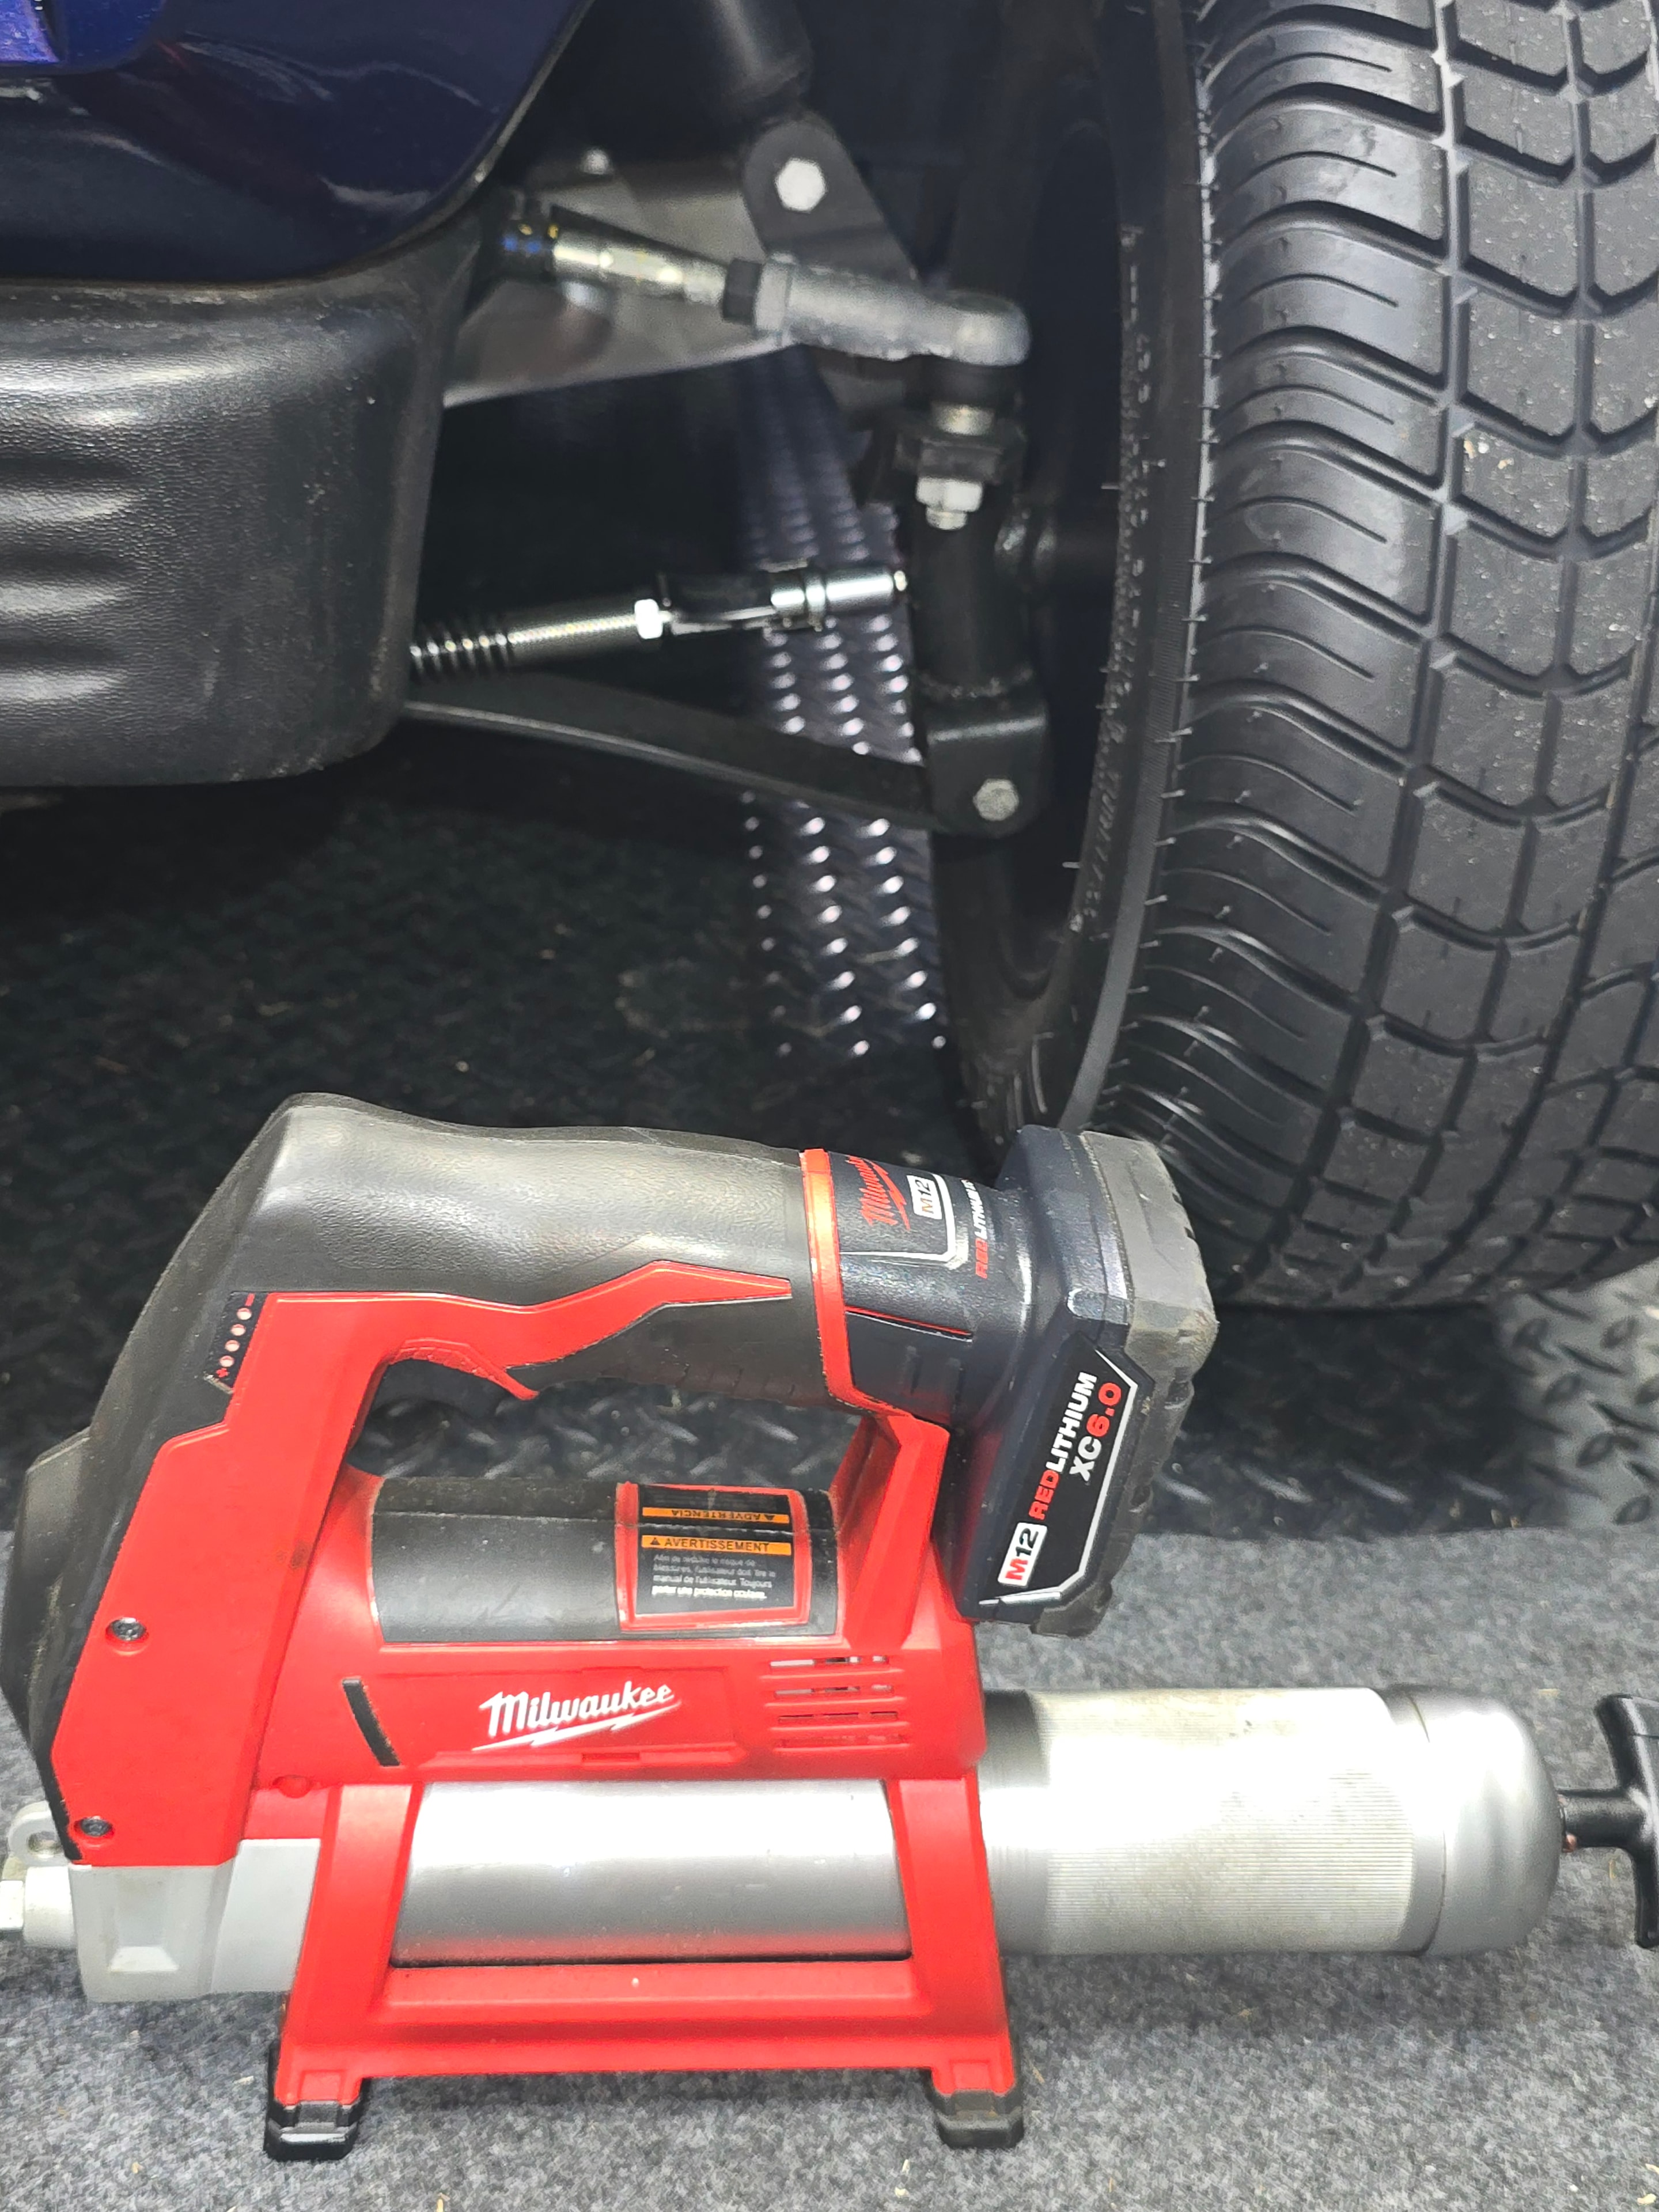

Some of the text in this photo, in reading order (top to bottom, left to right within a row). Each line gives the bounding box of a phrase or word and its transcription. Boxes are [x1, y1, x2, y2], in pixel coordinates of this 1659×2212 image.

[915, 1179, 935, 1214] M12
[1070, 1382, 1122, 1482] XC6.0
[1005, 1372, 1097, 1580] M12 REDLITHIUM
[671, 1509, 760, 1520] ADVERTENCIA
[664, 1537, 769, 1552] AVERTISSEMENT
[479, 1680, 675, 1738] Milwaukee
